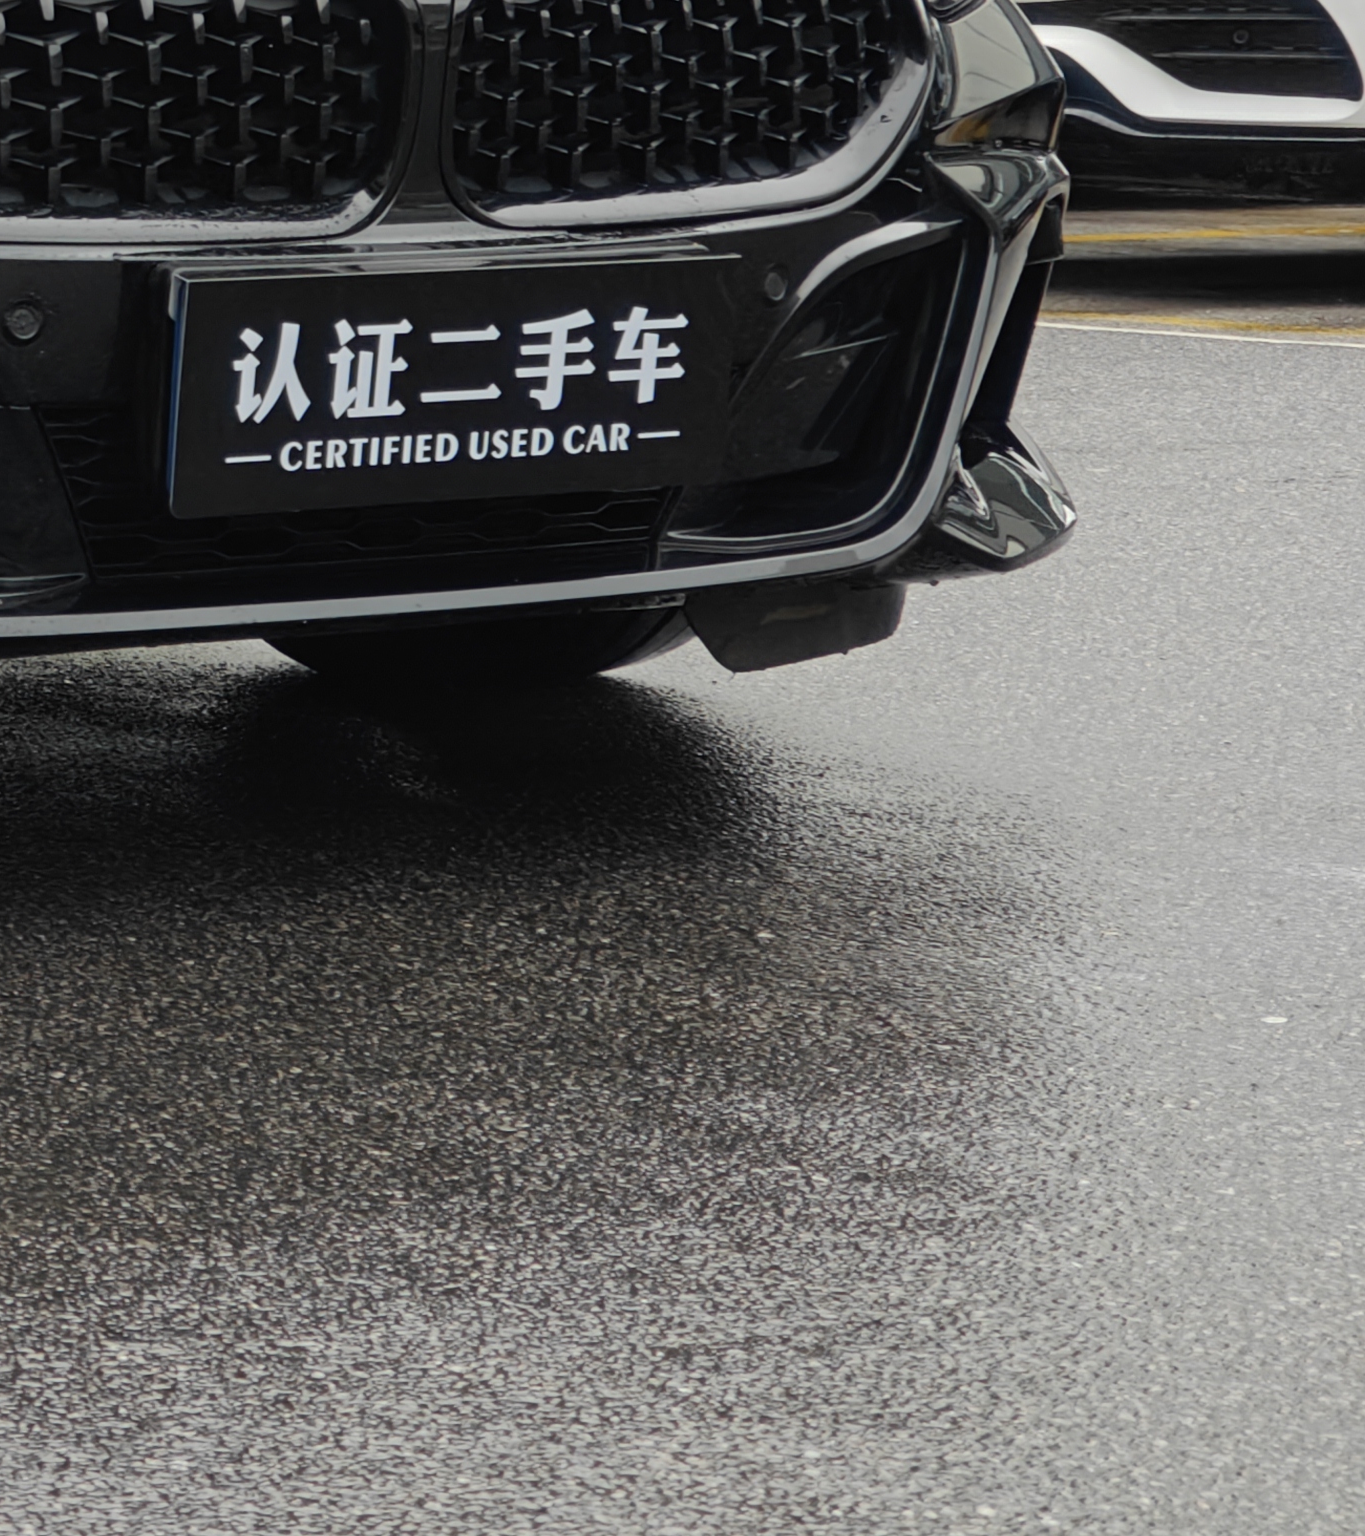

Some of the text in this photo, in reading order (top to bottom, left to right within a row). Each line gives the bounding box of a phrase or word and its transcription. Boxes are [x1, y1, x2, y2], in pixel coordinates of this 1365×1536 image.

[232, 306, 689, 424] 认证二手车
[279, 422, 633, 472] CERTIFIED USED CAR
